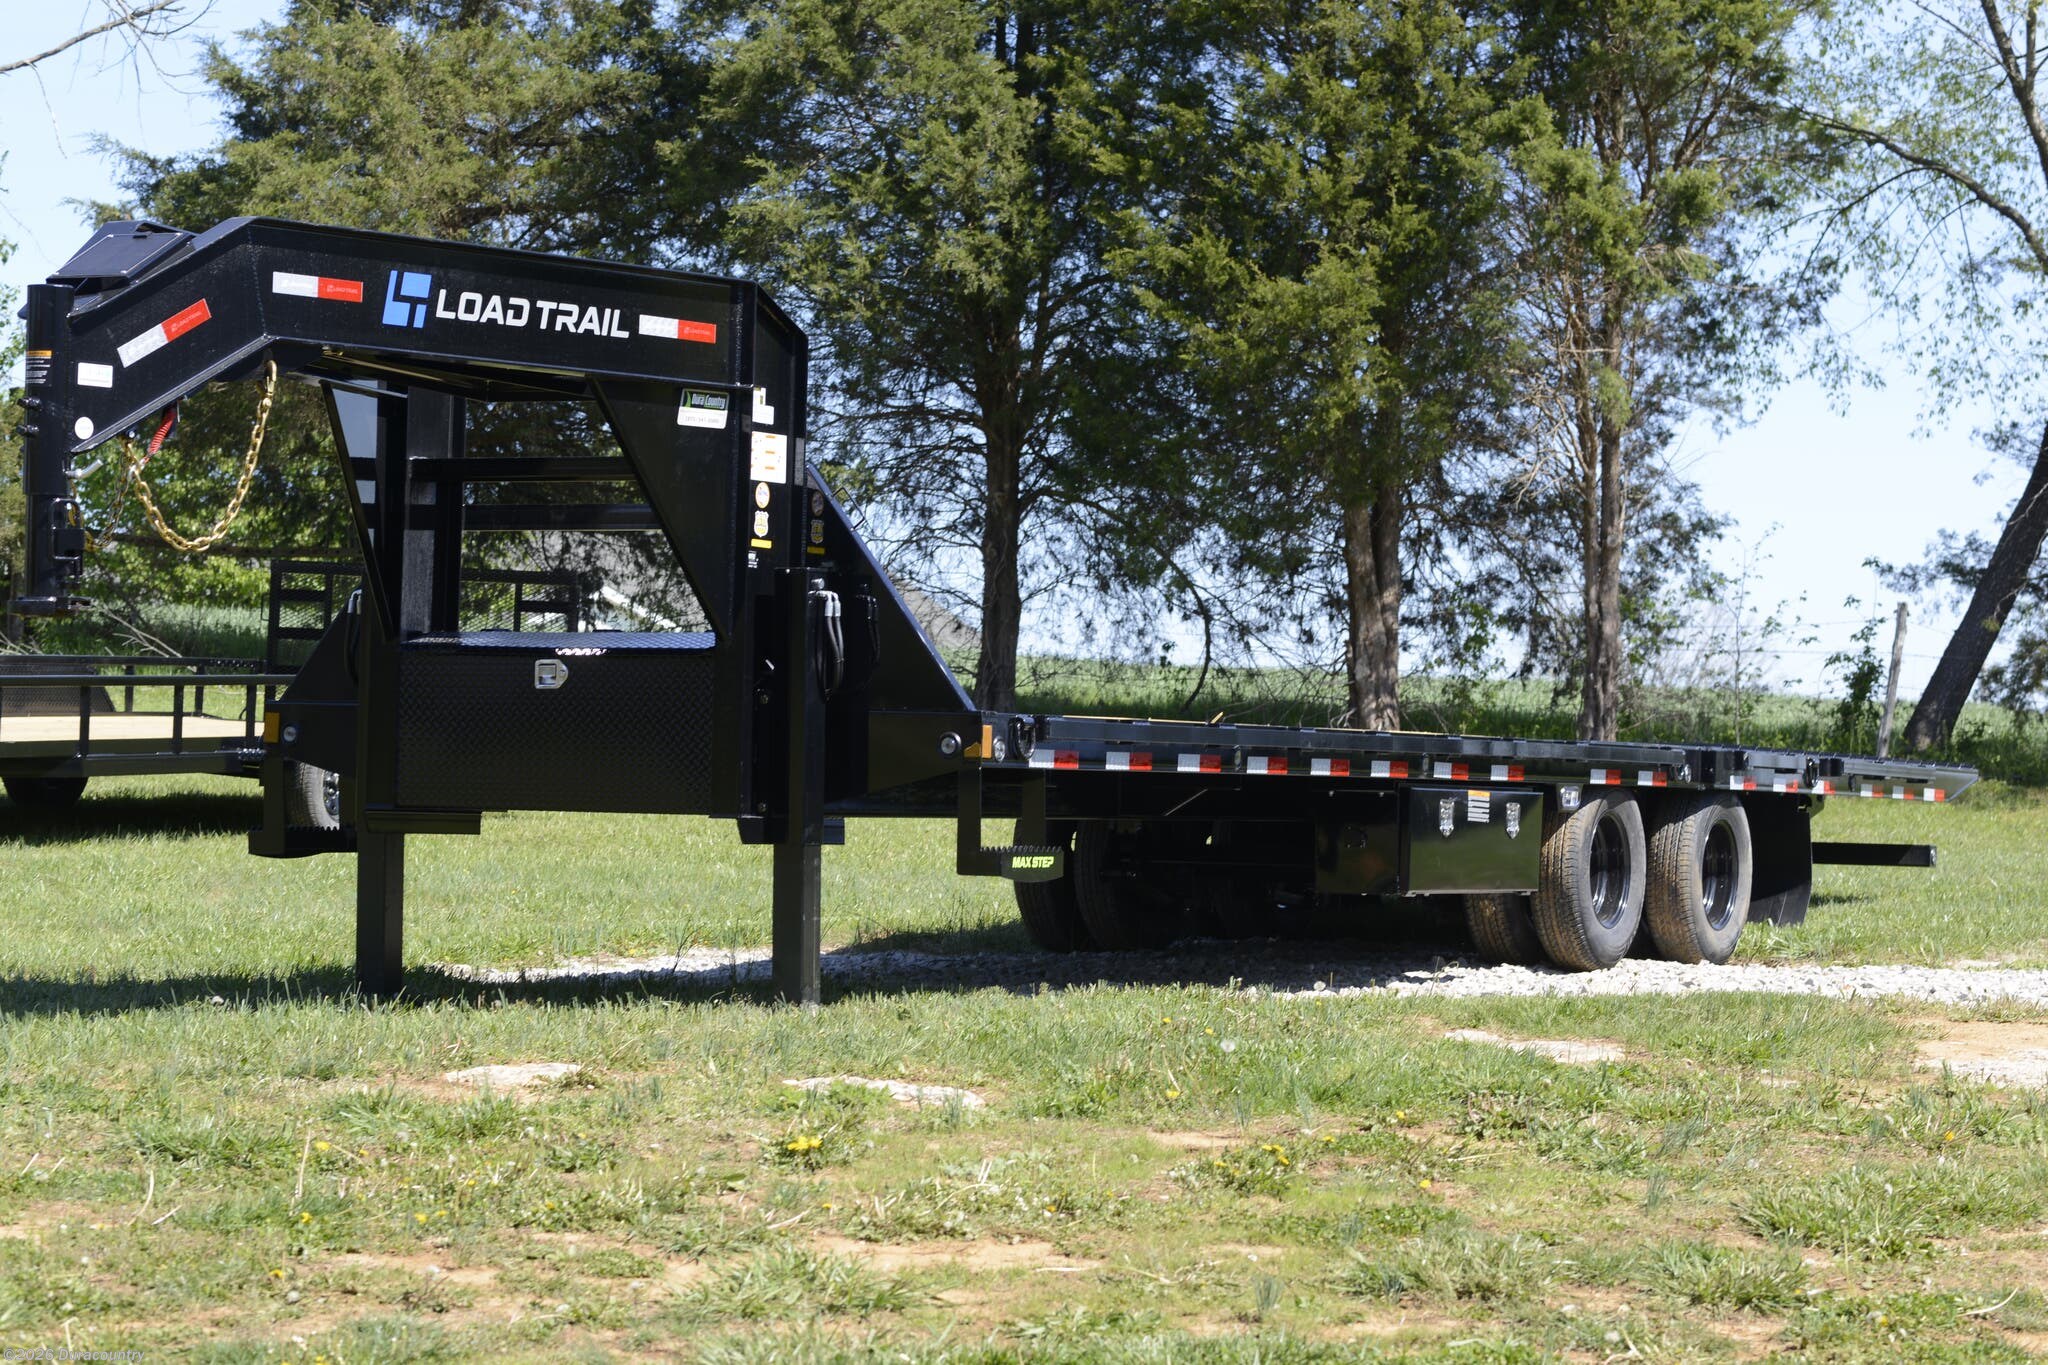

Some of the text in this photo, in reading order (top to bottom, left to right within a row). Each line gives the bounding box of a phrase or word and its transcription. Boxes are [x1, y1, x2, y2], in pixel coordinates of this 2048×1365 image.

[435, 289, 630, 338] LOAD TRAIL
[1012, 856, 1054, 868] MAX STEP
